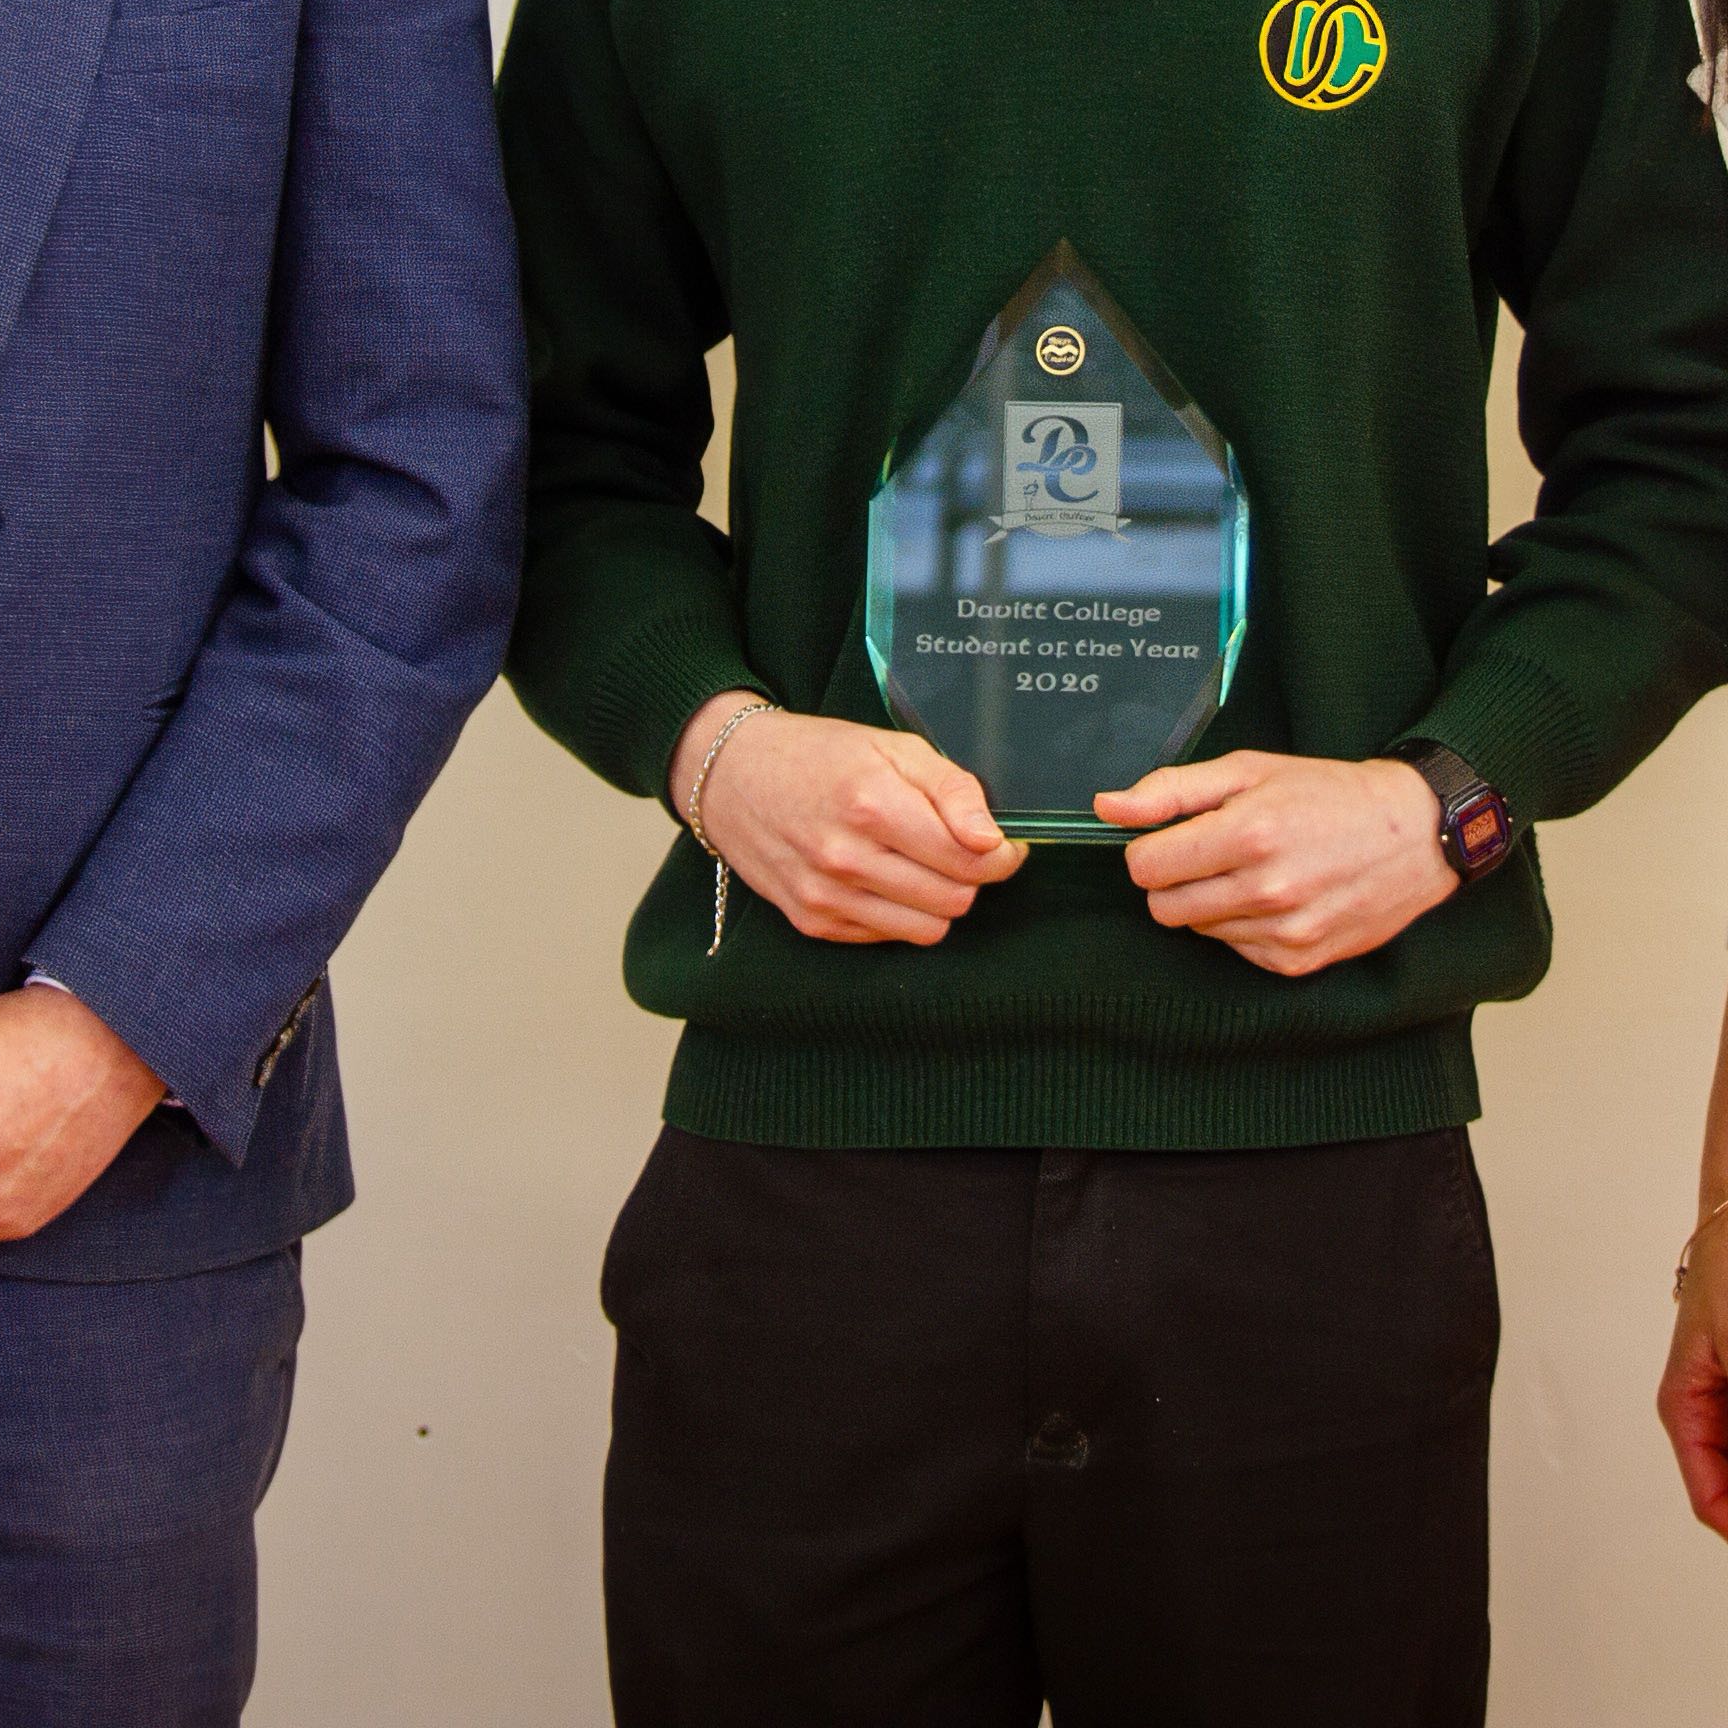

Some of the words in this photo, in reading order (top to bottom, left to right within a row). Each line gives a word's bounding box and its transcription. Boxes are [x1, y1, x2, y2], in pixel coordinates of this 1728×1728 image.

[957, 599, 1049, 620] Davitt
[1054, 601, 1162, 627] College
[916, 633, 1031, 655] Student
[1037, 640, 1069, 659] of
[1075, 638, 1123, 657] the
[1129, 638, 1200, 660] Year
[1015, 672, 1100, 693] 2026
